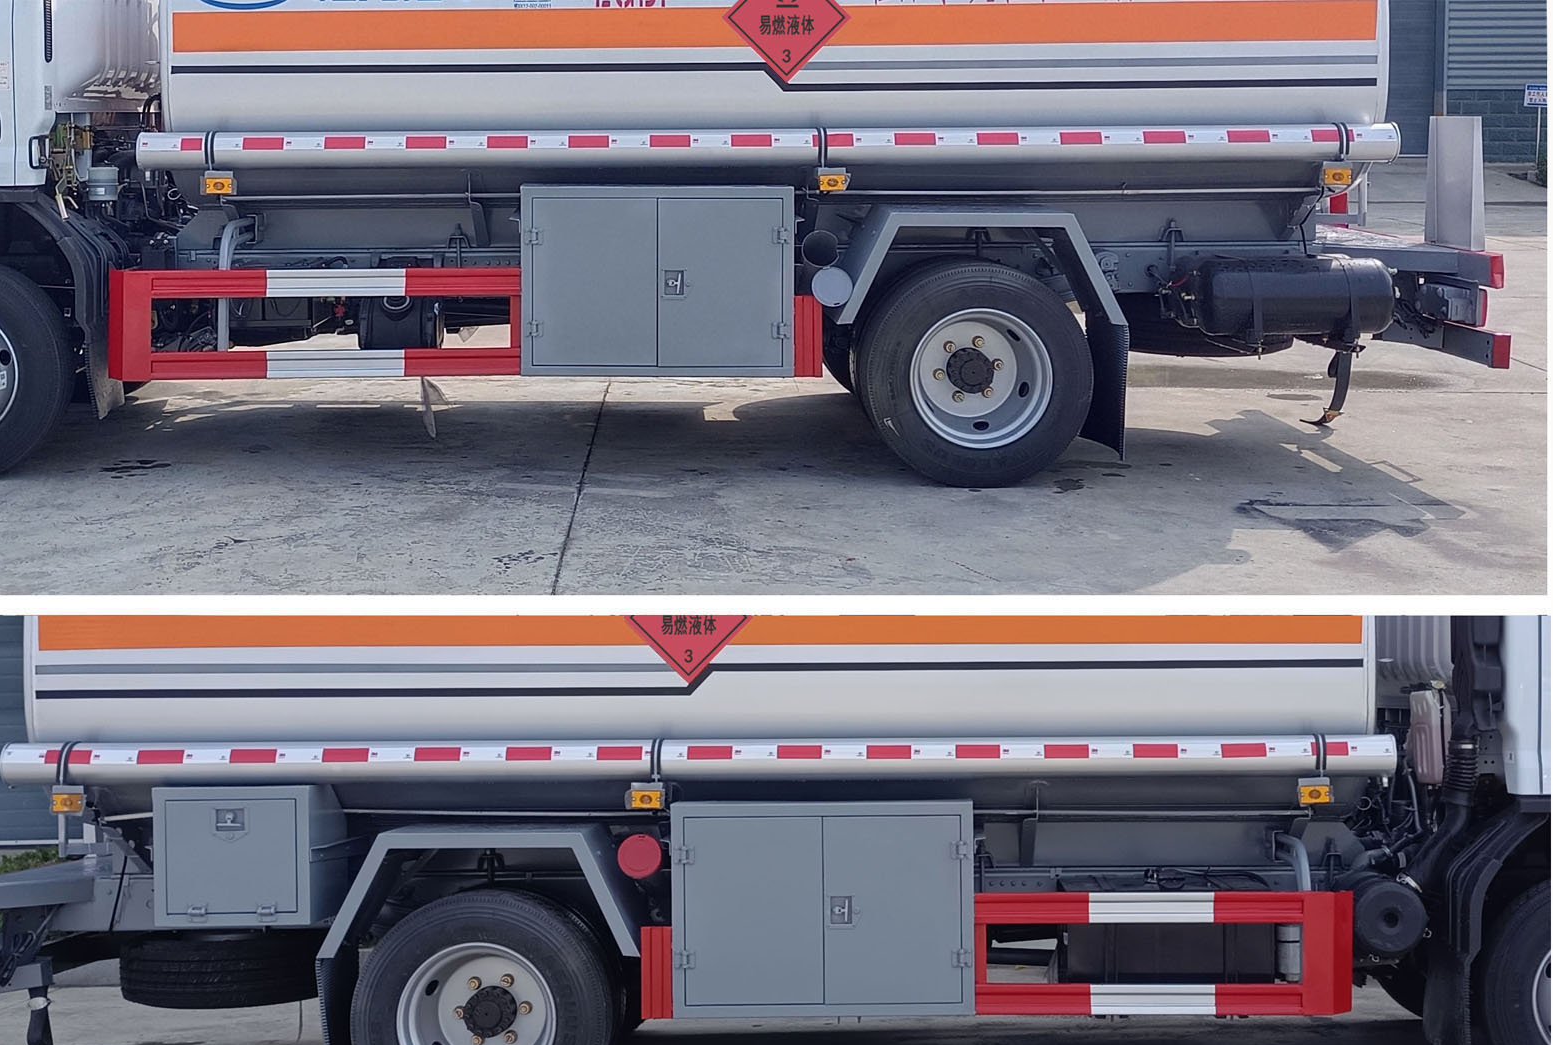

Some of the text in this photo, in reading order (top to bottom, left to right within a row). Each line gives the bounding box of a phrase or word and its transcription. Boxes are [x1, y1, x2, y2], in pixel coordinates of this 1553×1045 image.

[758, 14, 815, 36] 易燃液体
[782, 48, 792, 63] 3
[661, 615, 717, 636] 易燃液体
[684, 649, 693, 663] 3
